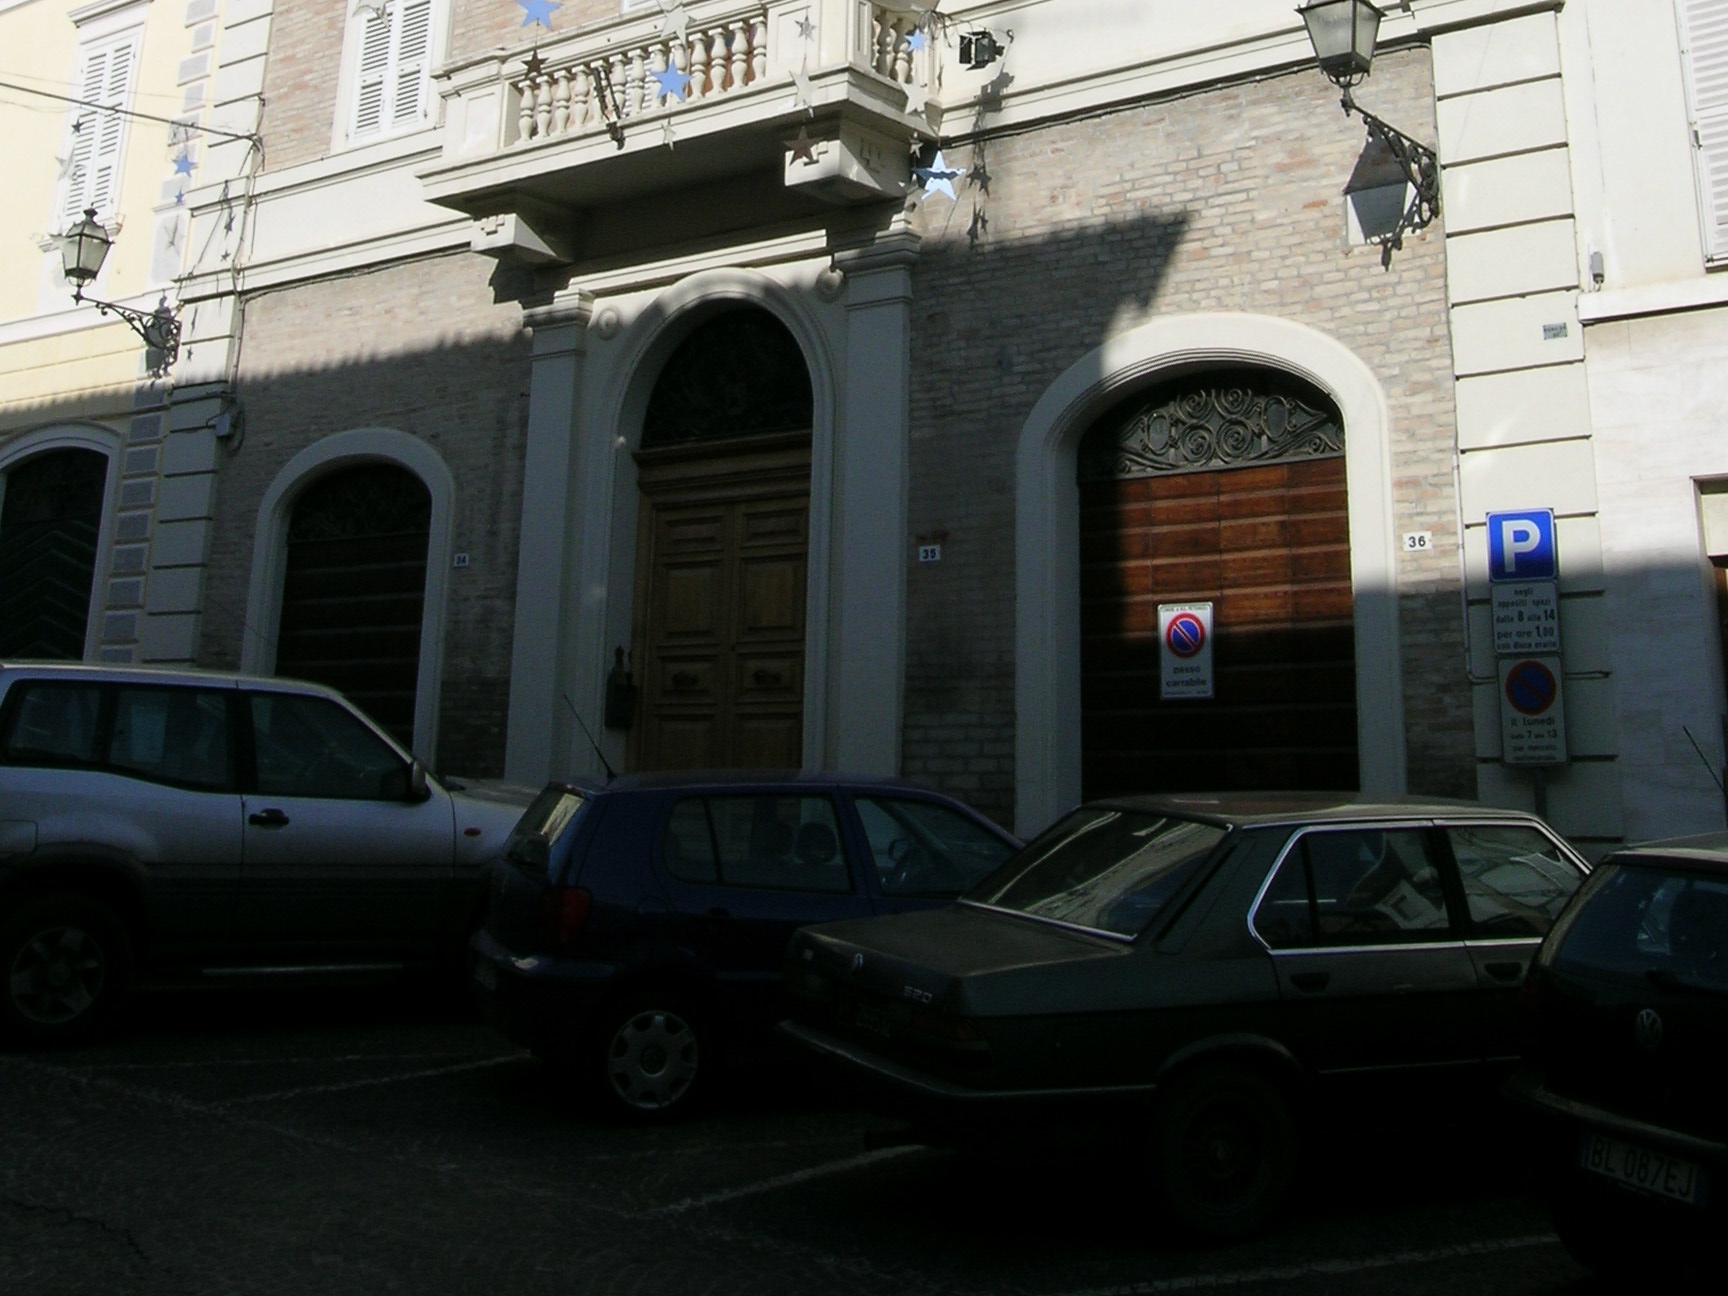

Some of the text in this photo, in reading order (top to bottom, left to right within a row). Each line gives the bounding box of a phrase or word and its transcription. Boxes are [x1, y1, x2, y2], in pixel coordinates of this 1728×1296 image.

[1408, 535, 1426, 548] 36
[1502, 519, 1541, 573] P
[923, 548, 936, 559] 35
[1517, 610, 1525, 622] 8
[1543, 609, 1555, 621] 14
[1497, 630, 1512, 640] per
[1516, 629, 1532, 638] ore
[1590, 1136, 1615, 1173] BL
